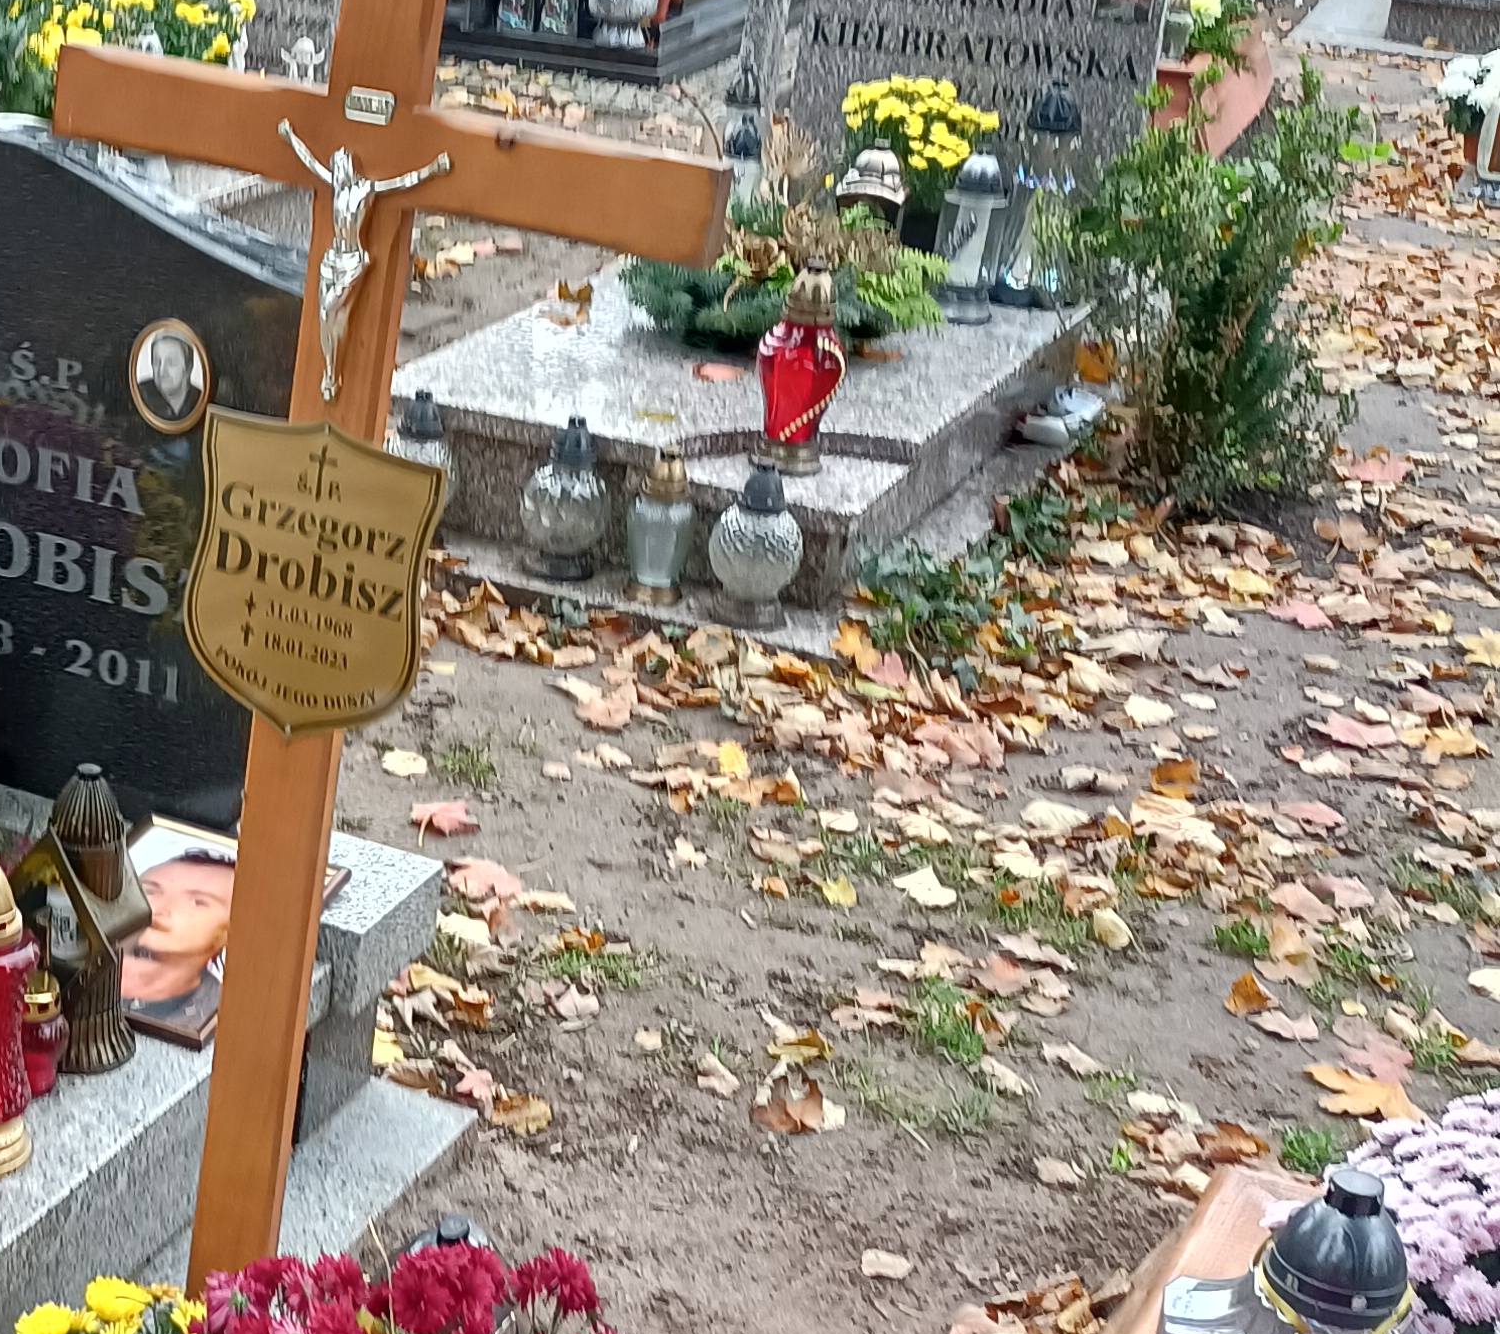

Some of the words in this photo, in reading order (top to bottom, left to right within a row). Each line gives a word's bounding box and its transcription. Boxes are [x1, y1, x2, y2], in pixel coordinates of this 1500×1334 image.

[221, 480, 407, 565] Grzegorz
[215, 527, 405, 622] Drobisz
[64, 639, 179, 703] 2011
[271, 680, 319, 709] JEGO
[323, 688, 378, 712] DUSZY
